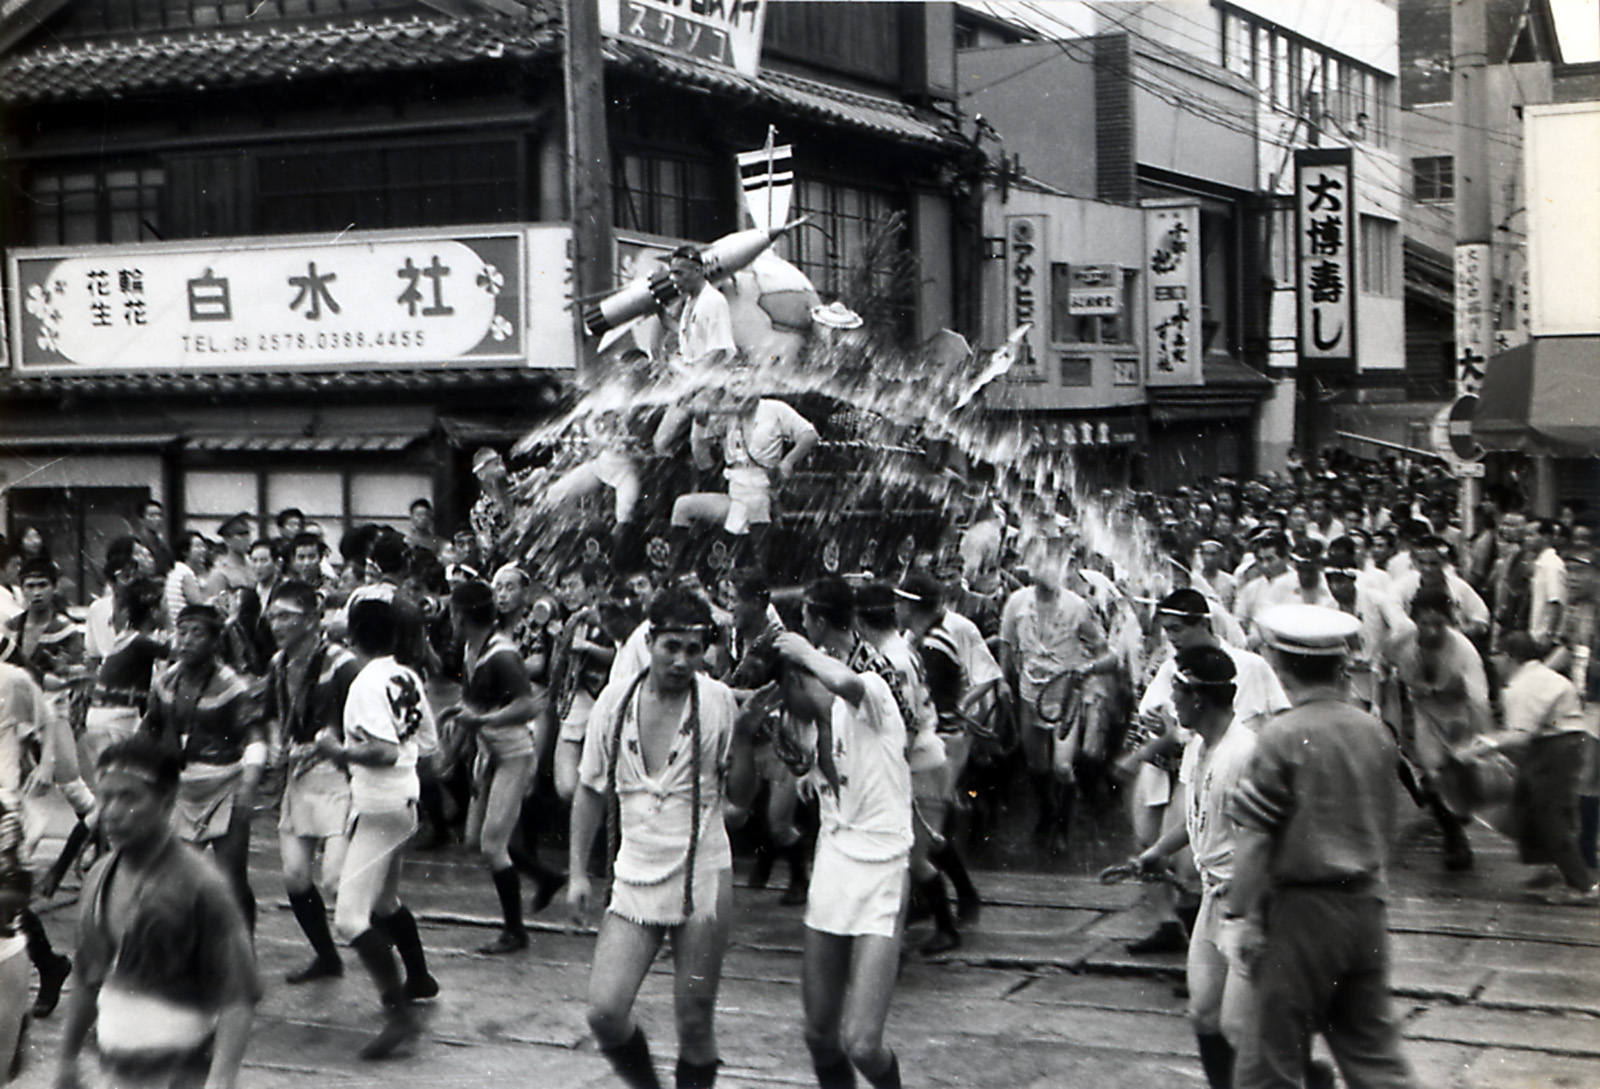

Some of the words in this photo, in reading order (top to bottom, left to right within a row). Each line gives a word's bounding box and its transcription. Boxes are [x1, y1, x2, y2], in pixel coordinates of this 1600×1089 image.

[86, 268, 144, 296] 花輪
[187, 255, 454, 322] 白水社
[90, 300, 148, 327] 生花
[181, 334, 228, 353] TEL.
